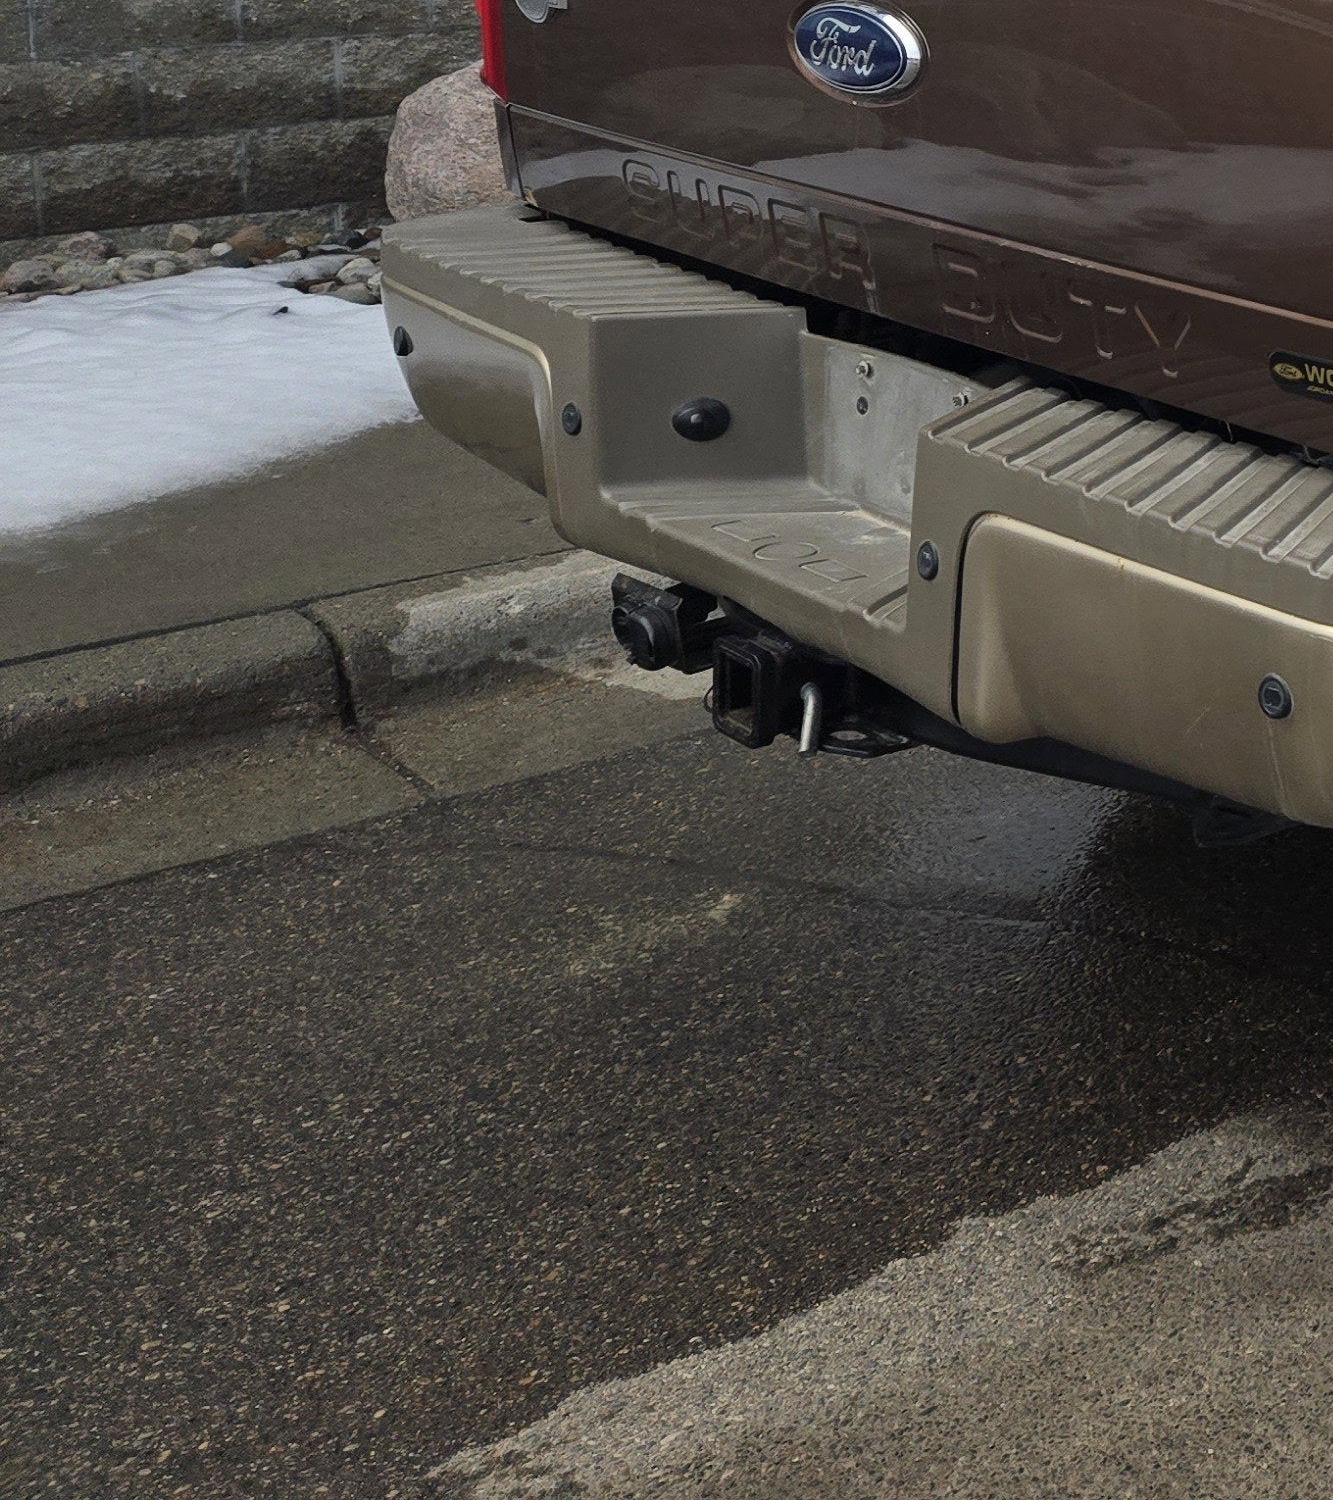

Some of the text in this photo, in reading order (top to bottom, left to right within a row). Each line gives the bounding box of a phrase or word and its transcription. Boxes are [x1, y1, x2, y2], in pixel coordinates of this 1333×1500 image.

[810, 17, 877, 76] Ford
[621, 158, 1194, 379] SUPER DUTY
